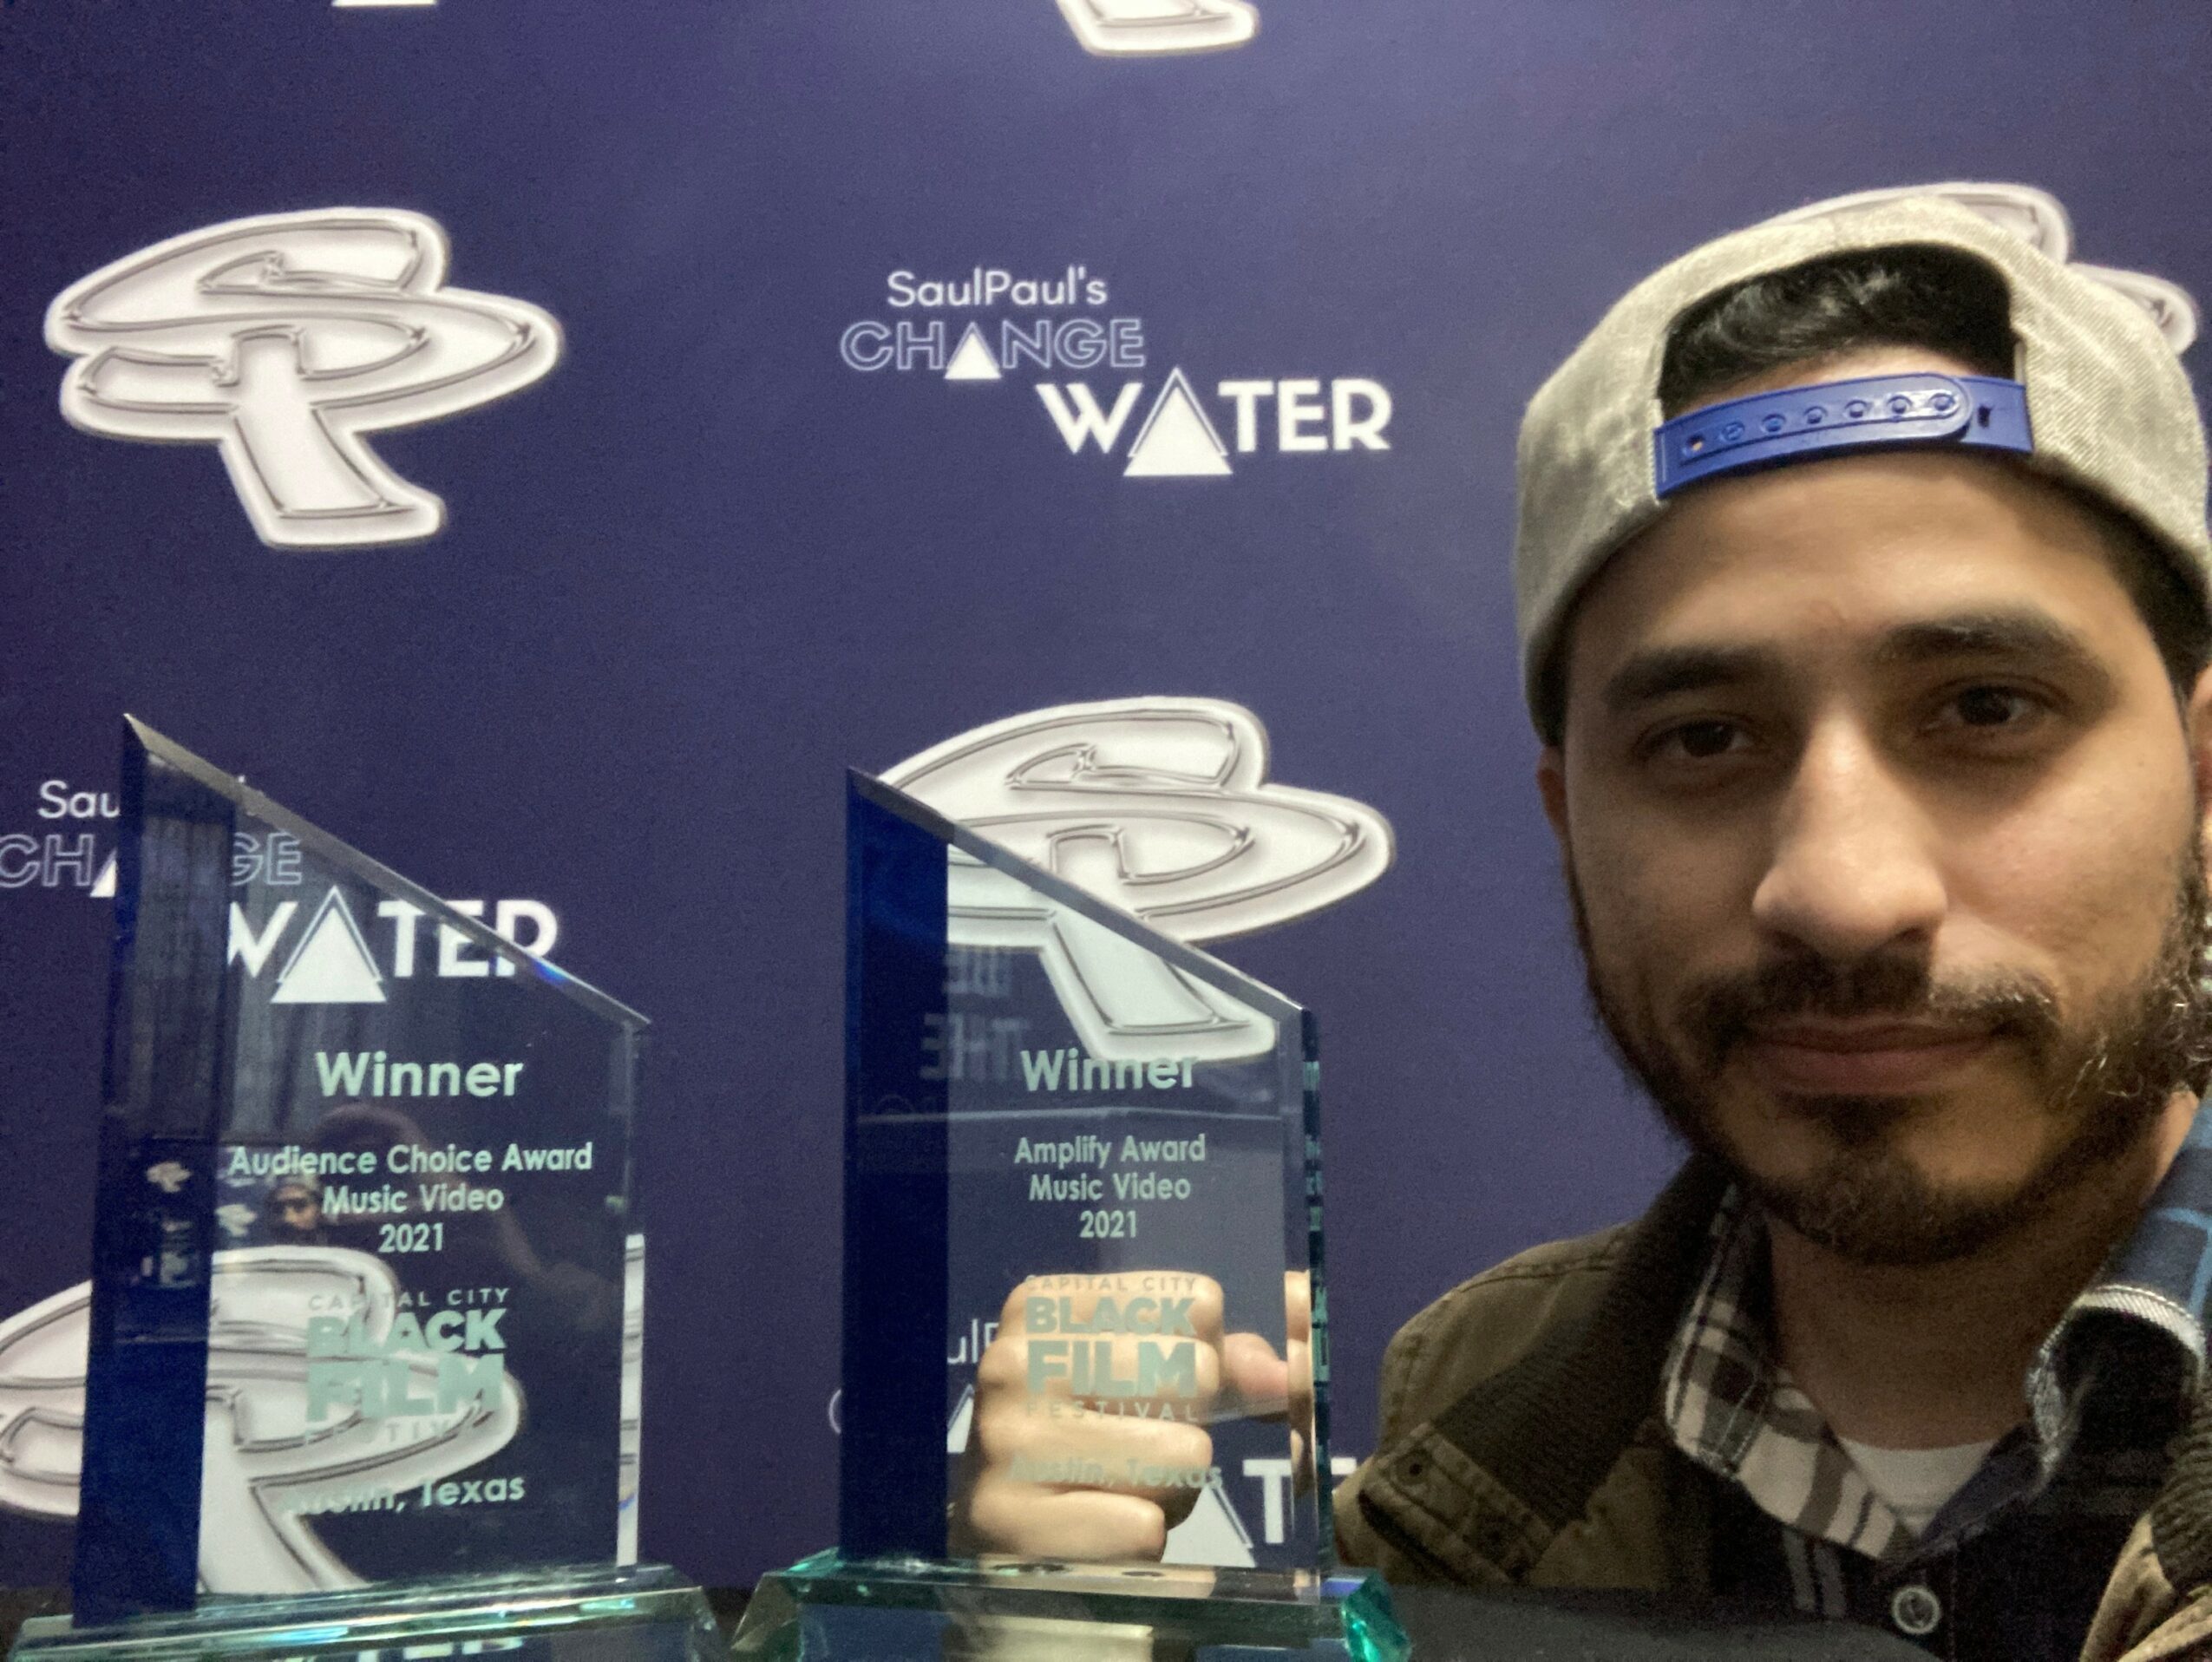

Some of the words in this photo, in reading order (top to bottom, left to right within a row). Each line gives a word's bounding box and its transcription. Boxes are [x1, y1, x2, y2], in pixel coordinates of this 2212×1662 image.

[886, 266, 1108, 307] SaulPaul's
[840, 317, 1147, 380] CHANGE
[1035, 366, 1393, 476] WATER
[0, 830, 302, 898] CHGE
[315, 1050, 524, 1097] Winner
[1020, 1048, 1200, 1093] Winner
[227, 1144, 376, 1178] Audience
[387, 1142, 493, 1175] Choice
[501, 1142, 593, 1172] Award
[1014, 1135, 1111, 1169] Amplify
[1120, 1133, 1207, 1163] Award
[322, 1183, 408, 1216] Music
[420, 1181, 505, 1212] Video
[1029, 1172, 1103, 1202] Music
[1112, 1171, 1192, 1201] Video
[378, 1222, 444, 1253] 2021
[1079, 1211, 1136, 1239] 2021
[307, 1289, 432, 1312] CAPTAL
[446, 1287, 510, 1305] CITY
[1025, 1275, 1129, 1292] CAPITAL
[1142, 1276, 1198, 1292] CITY
[306, 1308, 507, 1359] BLACK
[1024, 1296, 1197, 1337] BLACK
[1026, 1339, 1198, 1398] FILM
[306, 1353, 505, 1423] FILM
[1027, 1400, 1199, 1423] FESTIVAL
[419, 1476, 526, 1508] Texas
